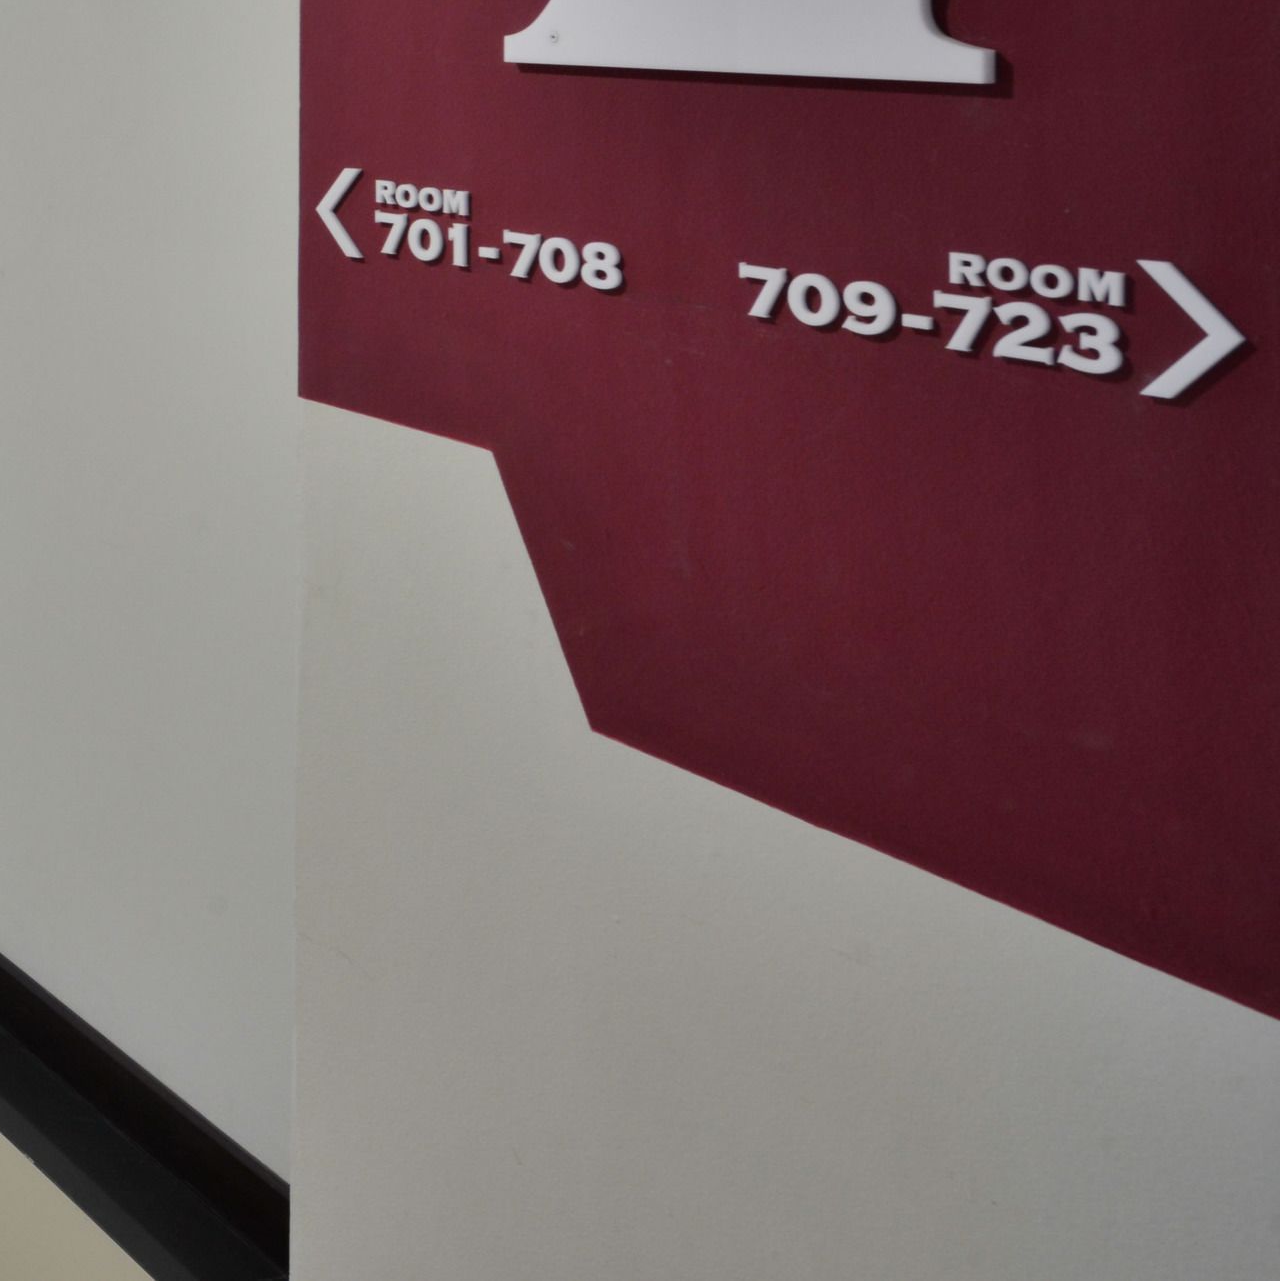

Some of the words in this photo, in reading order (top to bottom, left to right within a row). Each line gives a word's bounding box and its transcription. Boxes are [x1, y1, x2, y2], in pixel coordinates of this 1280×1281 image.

[374, 179, 470, 217] ROOM
[373, 210, 624, 291] 701-708
[947, 251, 1128, 307] ROOM
[737, 261, 1126, 375] 709-723
